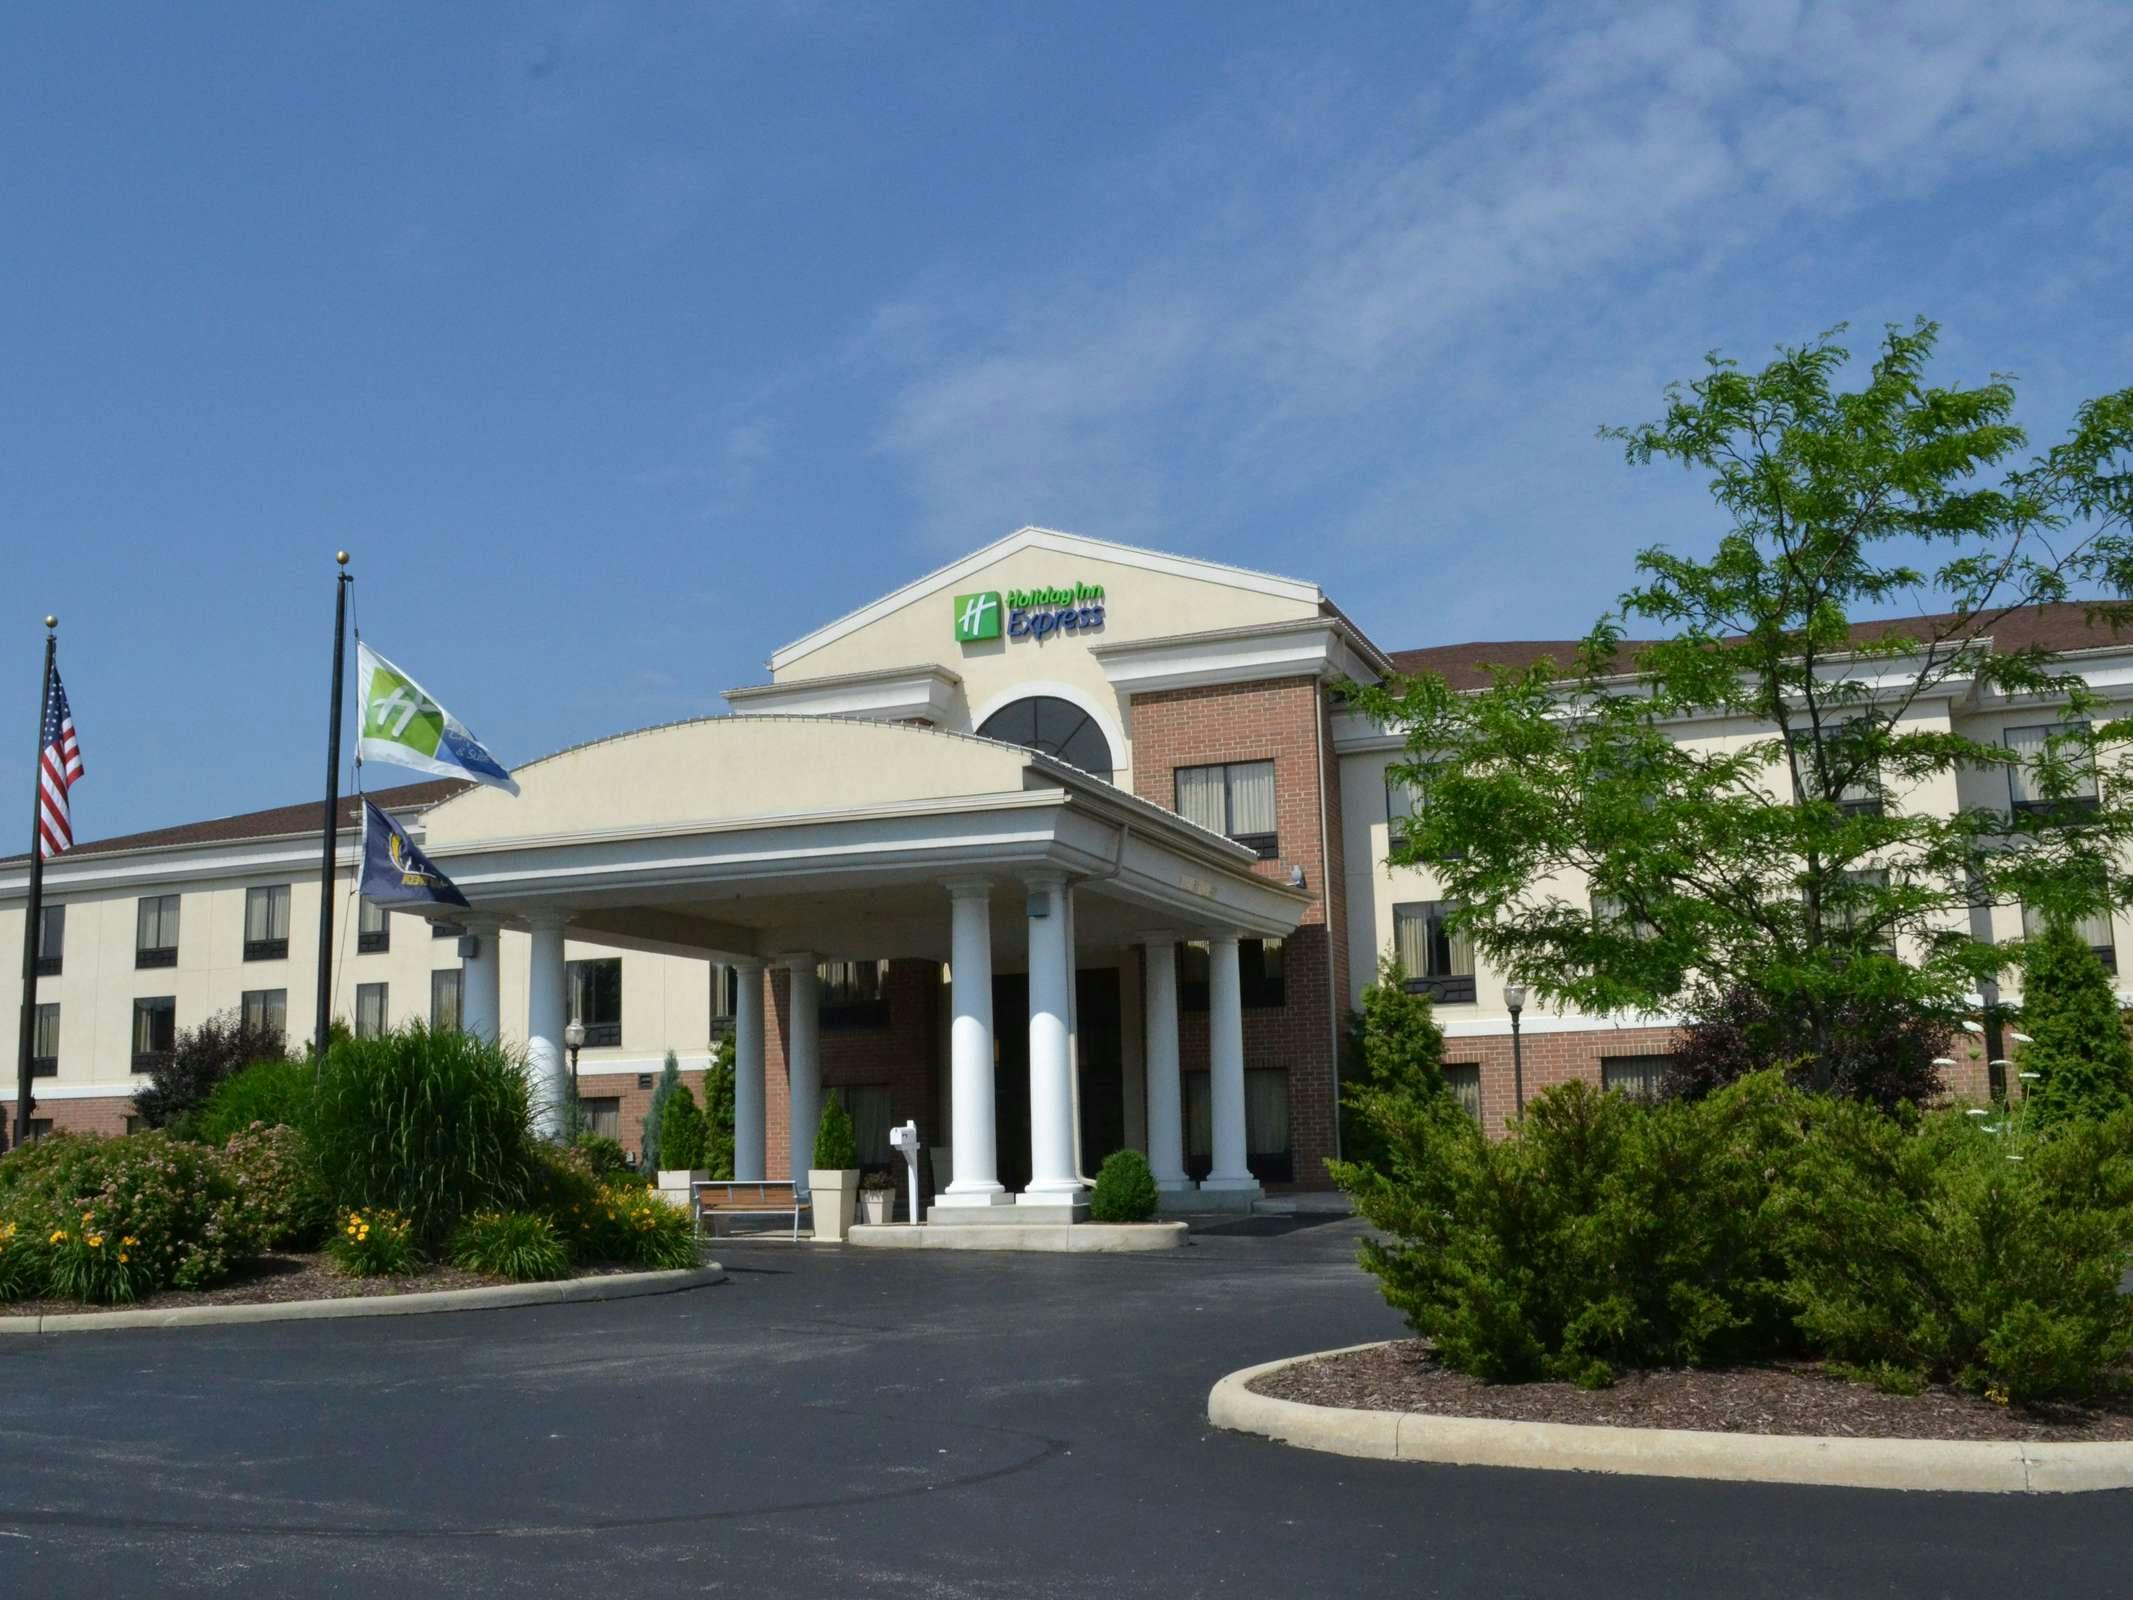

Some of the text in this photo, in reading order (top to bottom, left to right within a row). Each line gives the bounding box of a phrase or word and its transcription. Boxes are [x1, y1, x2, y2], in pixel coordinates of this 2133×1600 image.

[1006, 581, 1104, 609] Holiday Inn
[959, 594, 997, 636] H
[1007, 605, 1105, 641] Express
